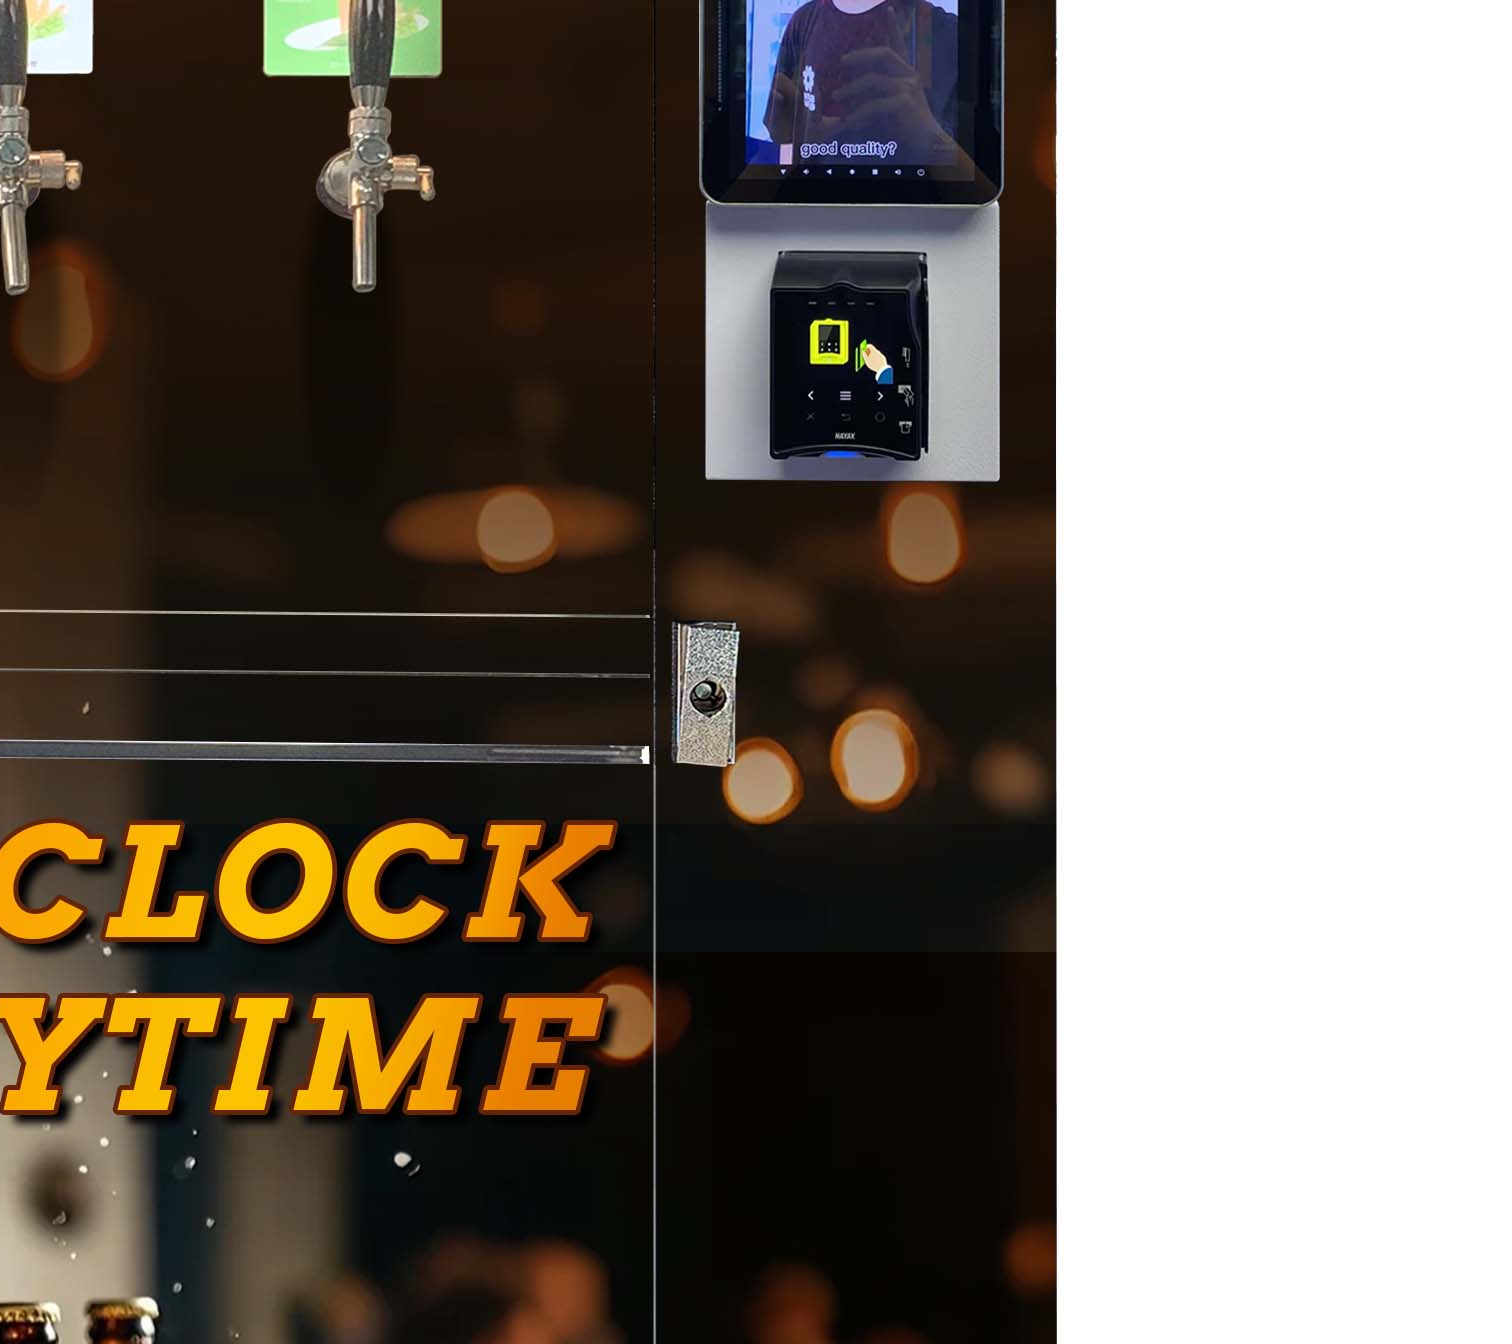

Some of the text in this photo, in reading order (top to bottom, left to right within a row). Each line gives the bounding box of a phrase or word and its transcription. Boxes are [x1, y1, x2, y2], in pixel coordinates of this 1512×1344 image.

[800, 140, 897, 158] good quality?
[834, 432, 856, 440] NAYAX
